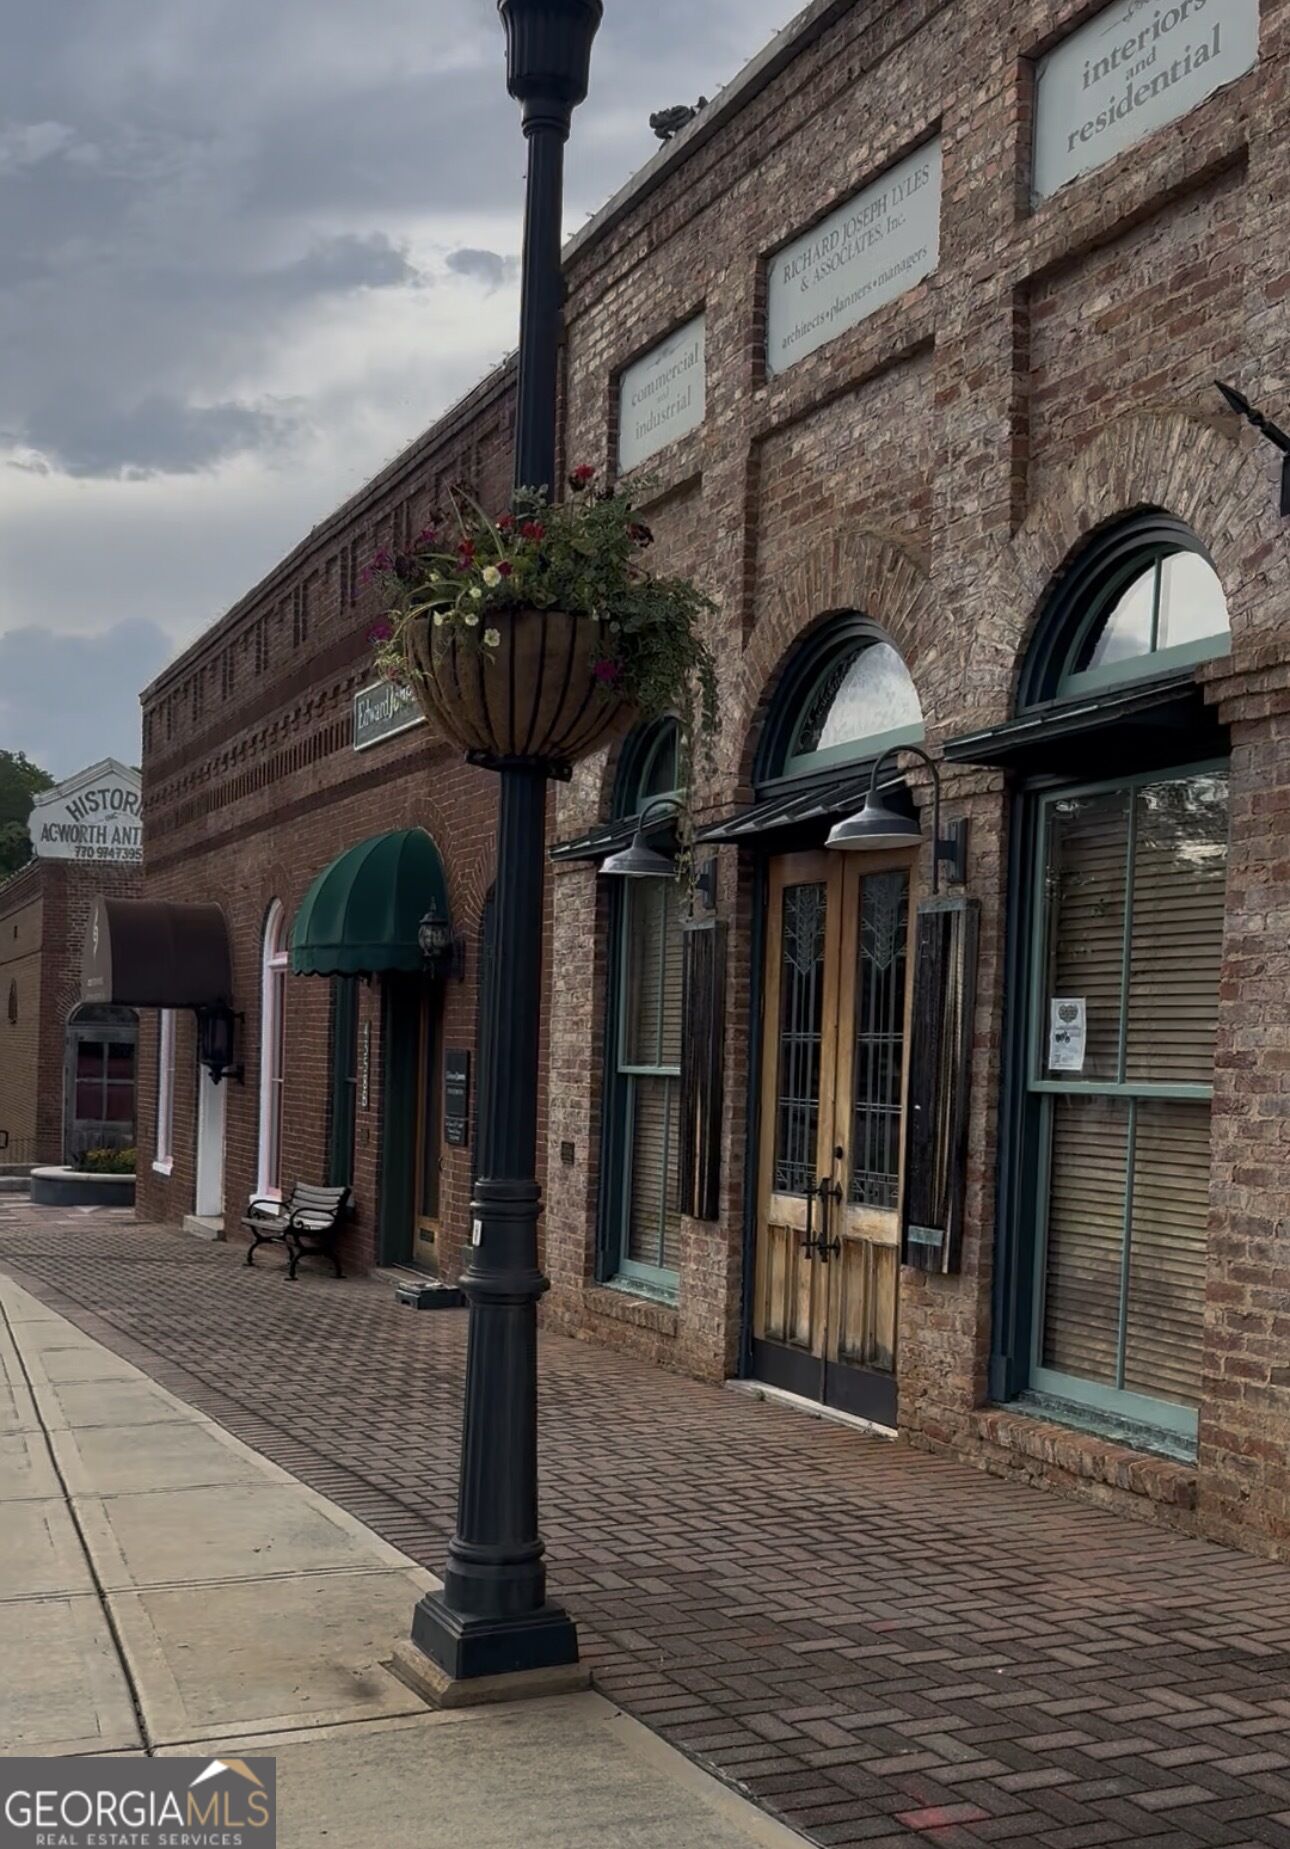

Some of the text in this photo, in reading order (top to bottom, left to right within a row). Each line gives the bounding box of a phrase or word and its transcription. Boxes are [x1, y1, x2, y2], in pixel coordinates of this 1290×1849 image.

[1067, 22, 1221, 153] residential
[1125, 46, 1157, 82] and
[783, 163, 930, 284] RICHARD JOSEPH LYLES
[800, 278, 810, 293] &
[886, 213, 907, 236] Inc.
[631, 341, 699, 407] commercial
[635, 384, 692, 440] industrial
[41, 823, 142, 845] ACWORTH ANT
[75, 845, 95, 858] 770
